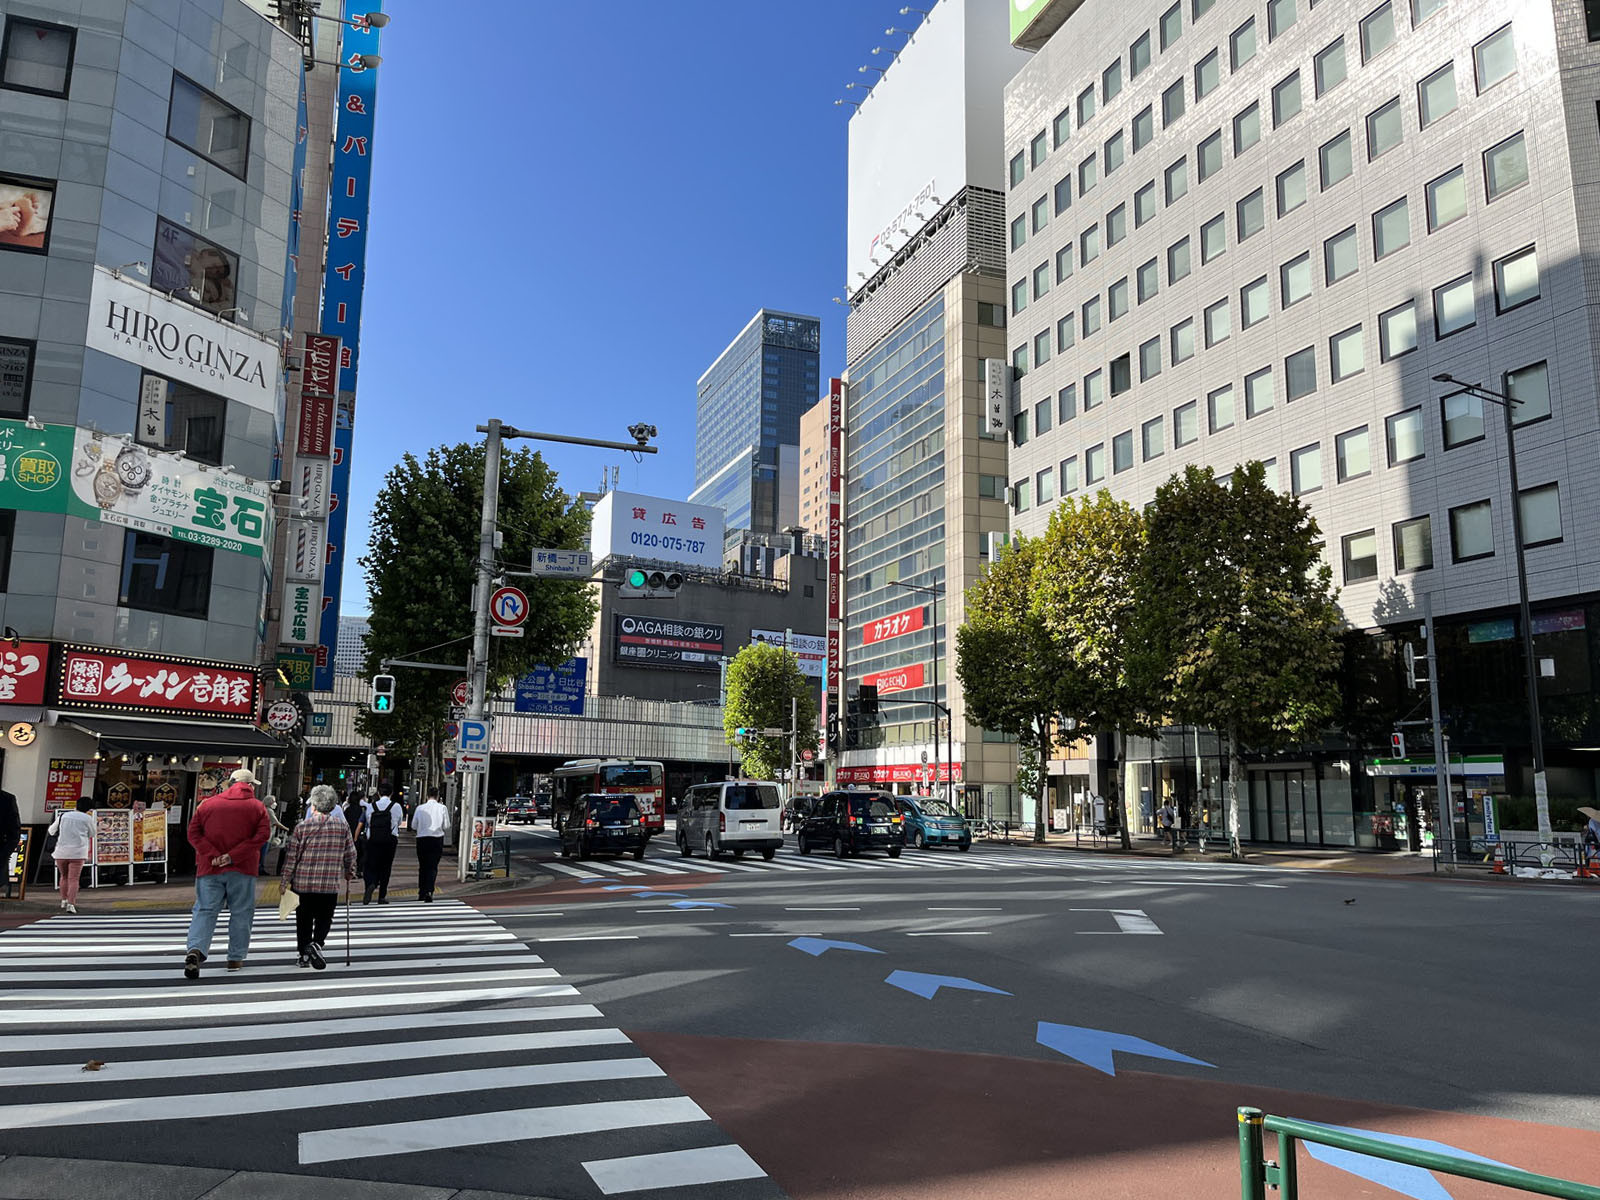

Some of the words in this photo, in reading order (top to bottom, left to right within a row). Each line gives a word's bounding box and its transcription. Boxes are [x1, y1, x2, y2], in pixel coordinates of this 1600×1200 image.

[162, 227, 179, 245] 4F
[106, 299, 180, 358] HIRO
[184, 333, 266, 390] GINZA
[114, 332, 155, 353] HAIR
[178, 357, 226, 381] SALON
[309, 337, 332, 396] SARINA
[831, 393, 840, 433] カラオケ
[314, 402, 326, 452] relaxation
[19, 457, 56, 475] 買取
[18, 473, 55, 484] SHOP
[161, 475, 182, 488] 時計
[149, 493, 190, 511] 金・プラチナ
[151, 484, 191, 501] ダイヤモンド
[103, 511, 129, 525] 宝石広場
[151, 505, 186, 520] ジュエリー
[191, 486, 266, 540] 宝石
[631, 506, 707, 530] 貸広告
[178, 531, 188, 539] TEL
[188, 530, 243, 552] 03-3289-2020
[630, 531, 706, 554] 0120-075-787
[829, 517, 840, 560] カラオケ
[536, 552, 588, 566] 新橋一丁目
[545, 564, 574, 572] Shinbashi
[291, 586, 310, 642] 宝石広場
[635, 620, 723, 641] AGA相談の銀クリ
[873, 612, 911, 640] カラオケ
[828, 637, 839, 680] カラオケ
[71, 661, 100, 679] 横浜
[71, 677, 97, 694] 家系
[558, 677, 584, 688] 日比谷
[877, 677, 889, 692] BIG
[889, 673, 908, 688] ECHO
[268, 712, 296, 722] ラーメン
[828, 711, 837, 743] ダーツ
[461, 722, 486, 749] P
[49, 771, 69, 783] B1F
[873, 769, 889, 779] カラオケ
[1486, 797, 1494, 834] FamilyMart
